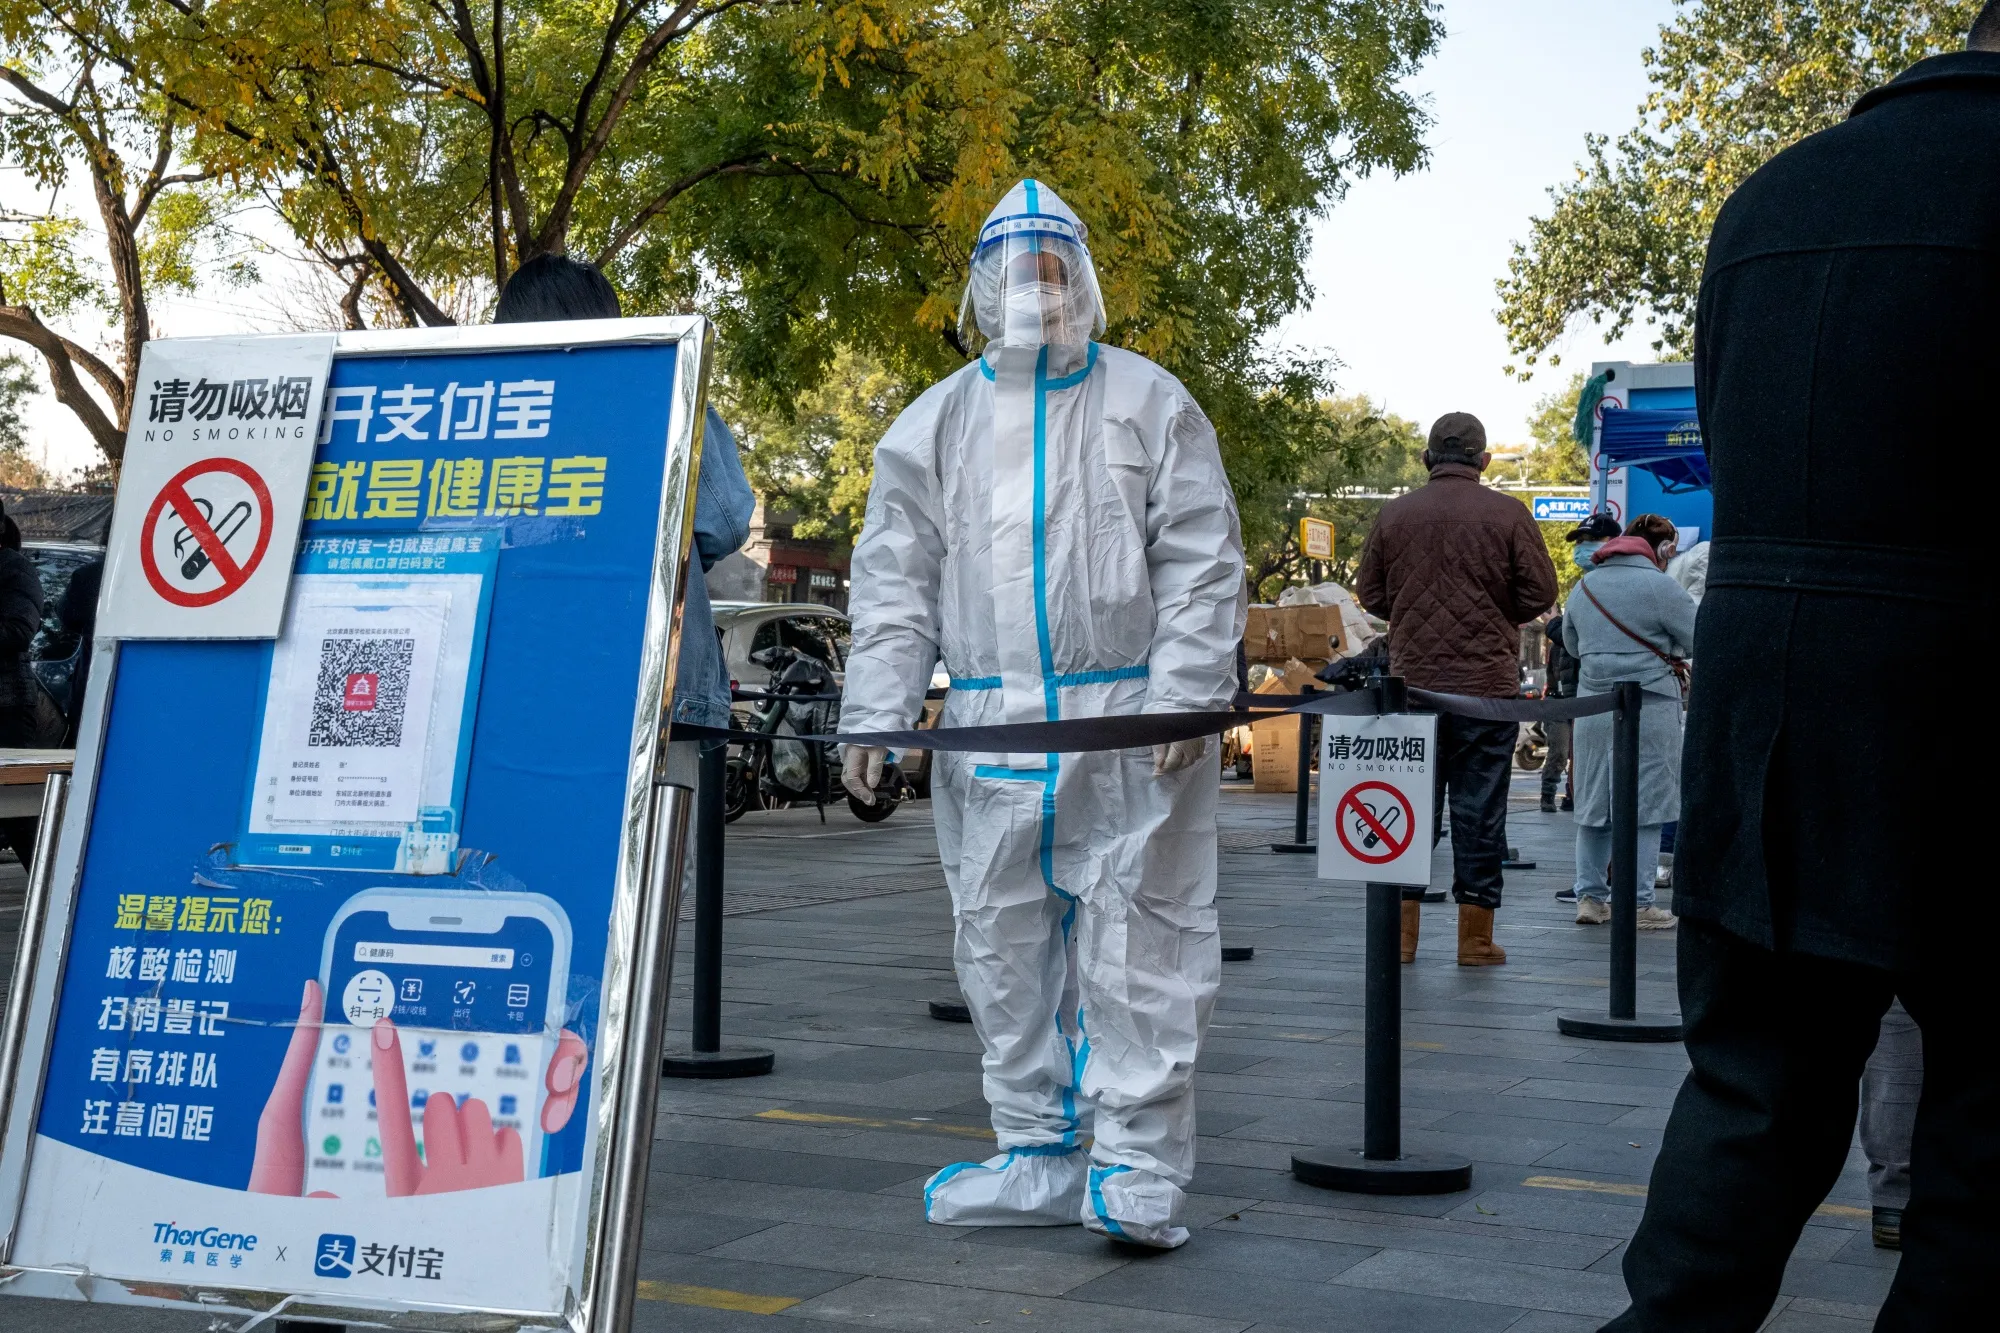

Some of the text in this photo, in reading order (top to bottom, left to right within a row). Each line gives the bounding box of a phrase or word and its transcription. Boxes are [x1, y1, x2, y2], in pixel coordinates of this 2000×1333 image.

[146, 376, 313, 424] 请勿吸烟
[145, 426, 305, 442] NO SMOKING
[306, 456, 608, 520] 就是健康宝
[1328, 734, 1425, 762] 请勿吸烟
[1328, 762, 1425, 774] NO SMOKING
[106, 945, 237, 984] 核酸检测
[369, 948, 507, 964] 健康码 搜索
[98, 996, 230, 1037] 扫码登记
[349, 1004, 385, 1019] 扫一扫
[453, 1008, 471, 1019] 出行
[507, 1011, 524, 1022] 卡包
[90, 1047, 219, 1089] 有序排队
[80, 1099, 214, 1142] 注意间距
[153, 1220, 258, 1252] ThorGene
[159, 1248, 243, 1269] 索真医学
[357, 1242, 445, 1280] 支付宝
